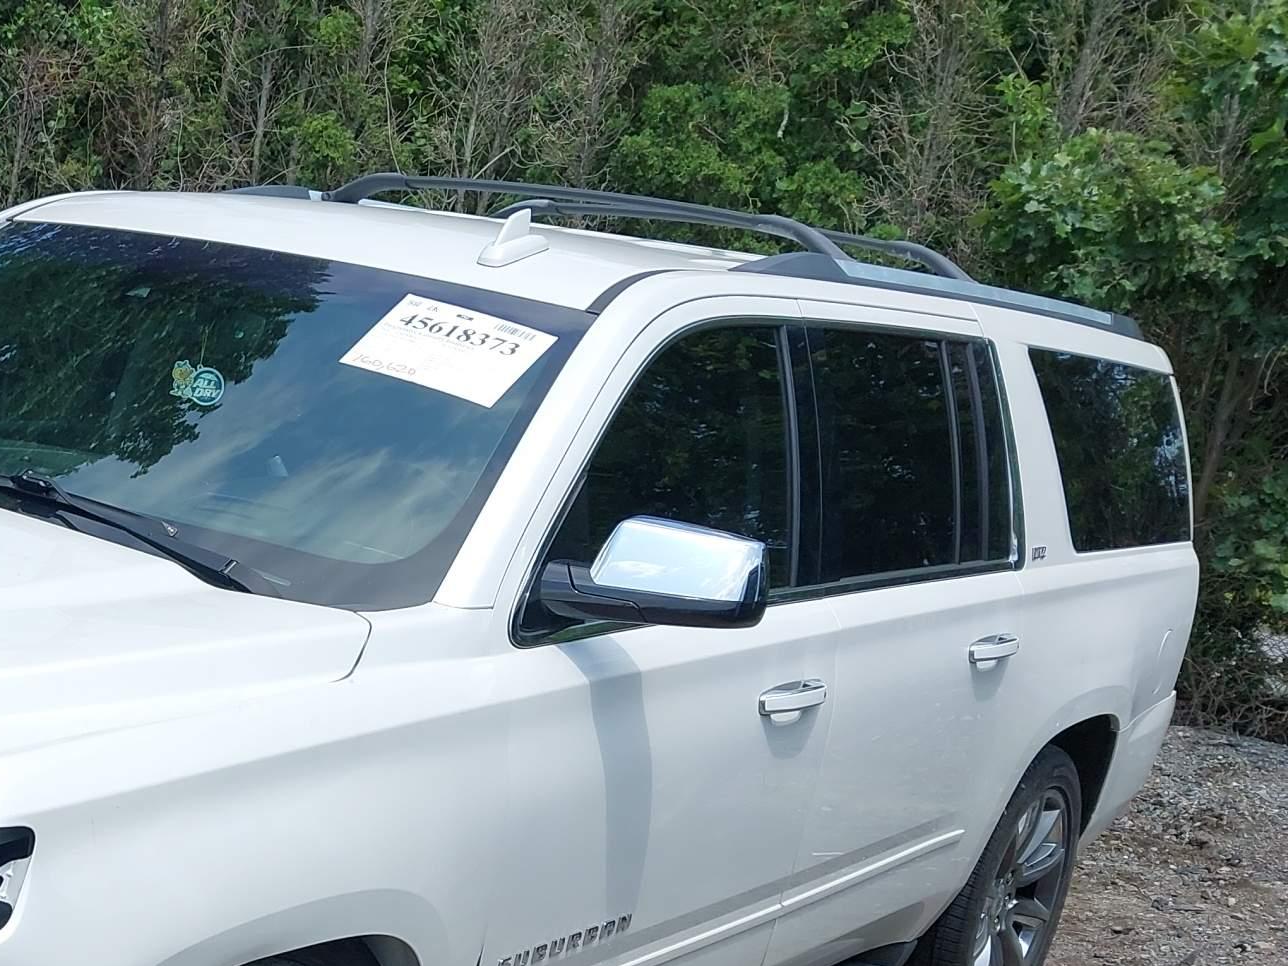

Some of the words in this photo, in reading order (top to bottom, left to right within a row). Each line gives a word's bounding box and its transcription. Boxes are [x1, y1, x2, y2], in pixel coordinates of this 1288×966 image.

[399, 313, 521, 356] 45618373
[192, 378, 217, 389] ALL
[193, 387, 221, 398] DRY
